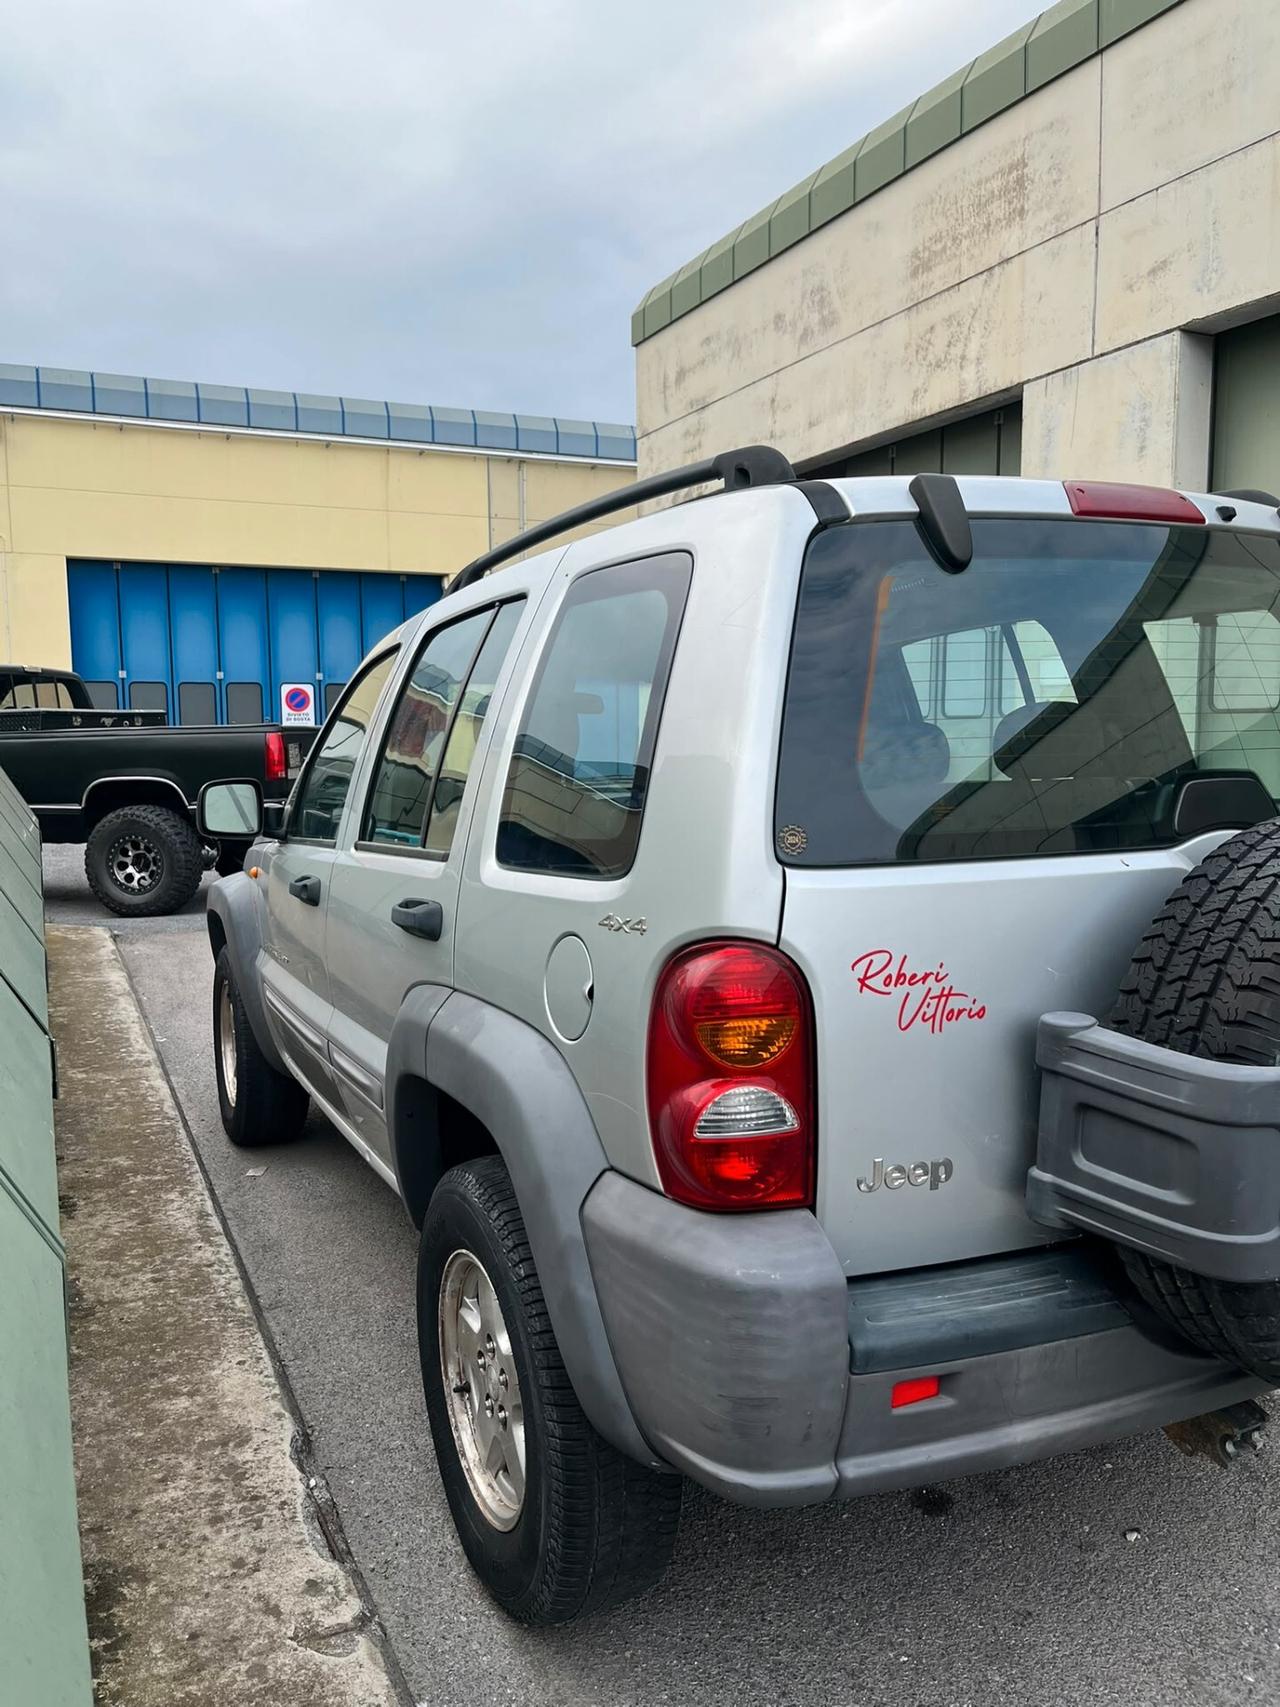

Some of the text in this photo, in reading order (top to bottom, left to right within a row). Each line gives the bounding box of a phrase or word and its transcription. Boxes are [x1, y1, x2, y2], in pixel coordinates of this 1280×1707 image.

[851, 950, 949, 995] Roberi
[898, 985, 986, 1034] Vittorio
[856, 1157, 953, 1193] Jeep
